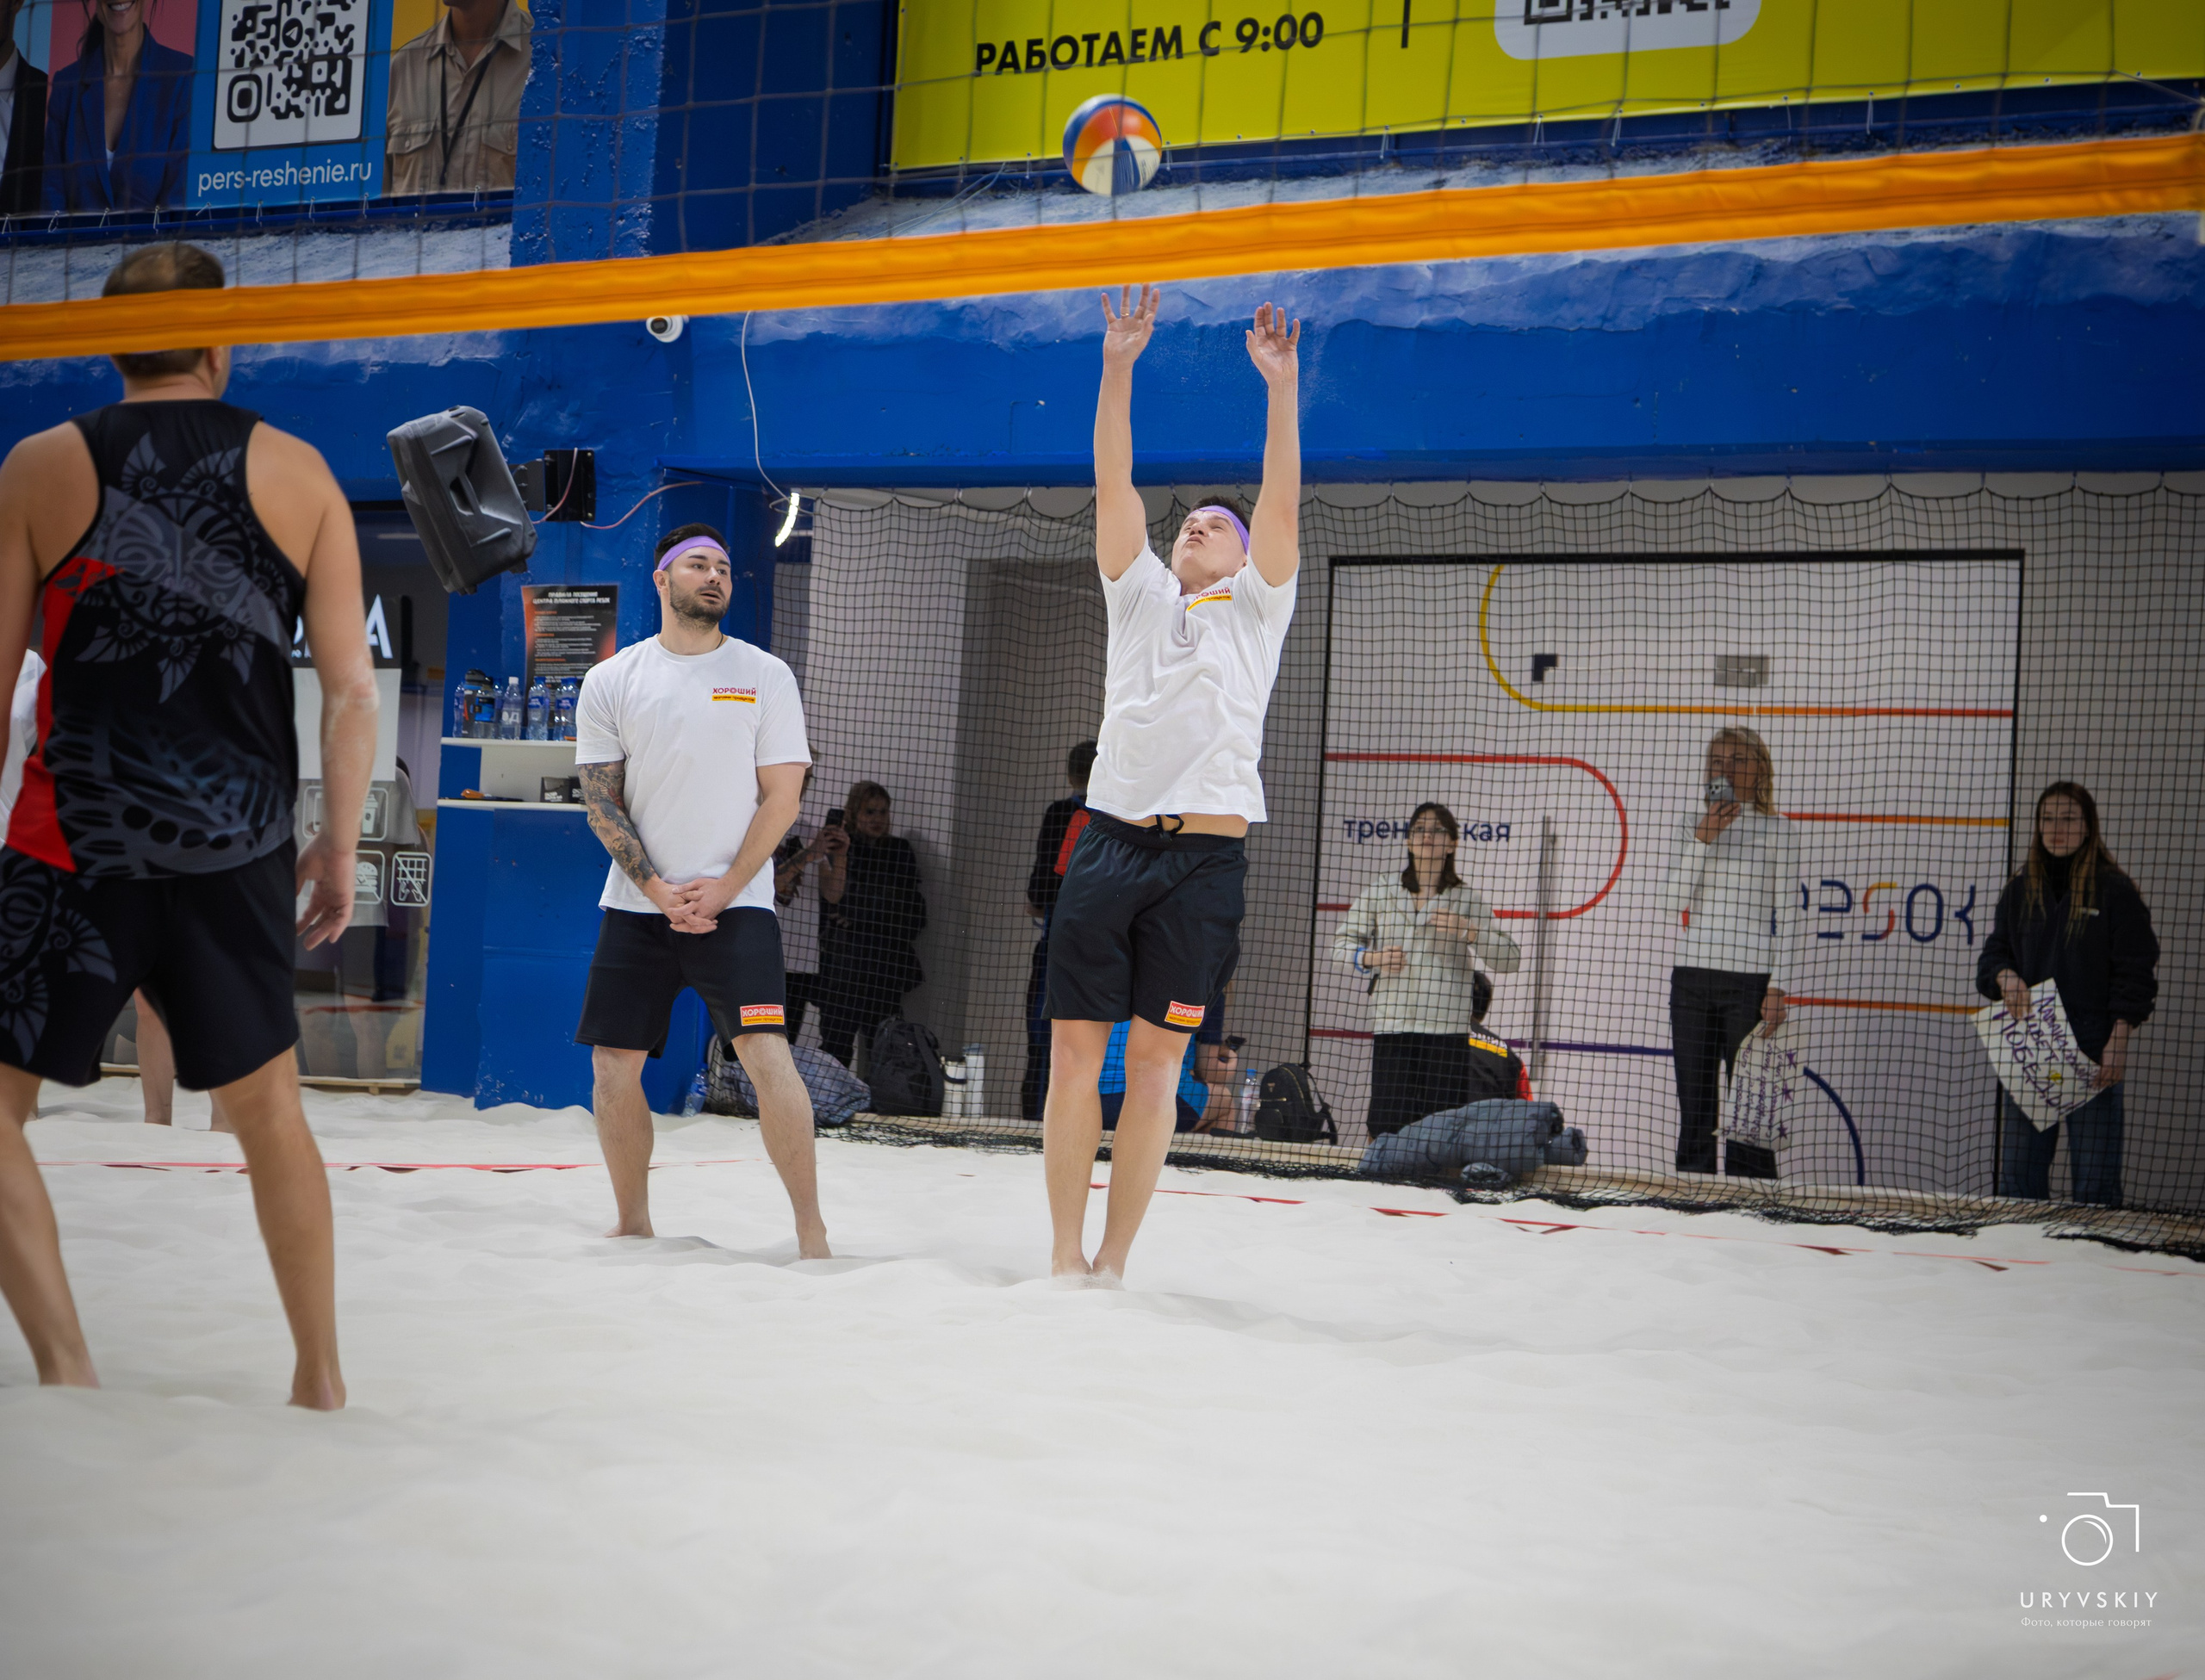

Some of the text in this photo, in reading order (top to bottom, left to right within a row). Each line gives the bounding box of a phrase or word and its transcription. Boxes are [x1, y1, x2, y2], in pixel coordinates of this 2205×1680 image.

[975, 11, 1324, 77] РАБОТАЕМ С 9:00
[197, 158, 372, 197] pers-reshenie.ru
[712, 687, 756, 696] ХОРОШИЙ
[1344, 820, 1510, 843] тренкая
[742, 1007, 783, 1017] ХОРОШИЙ
